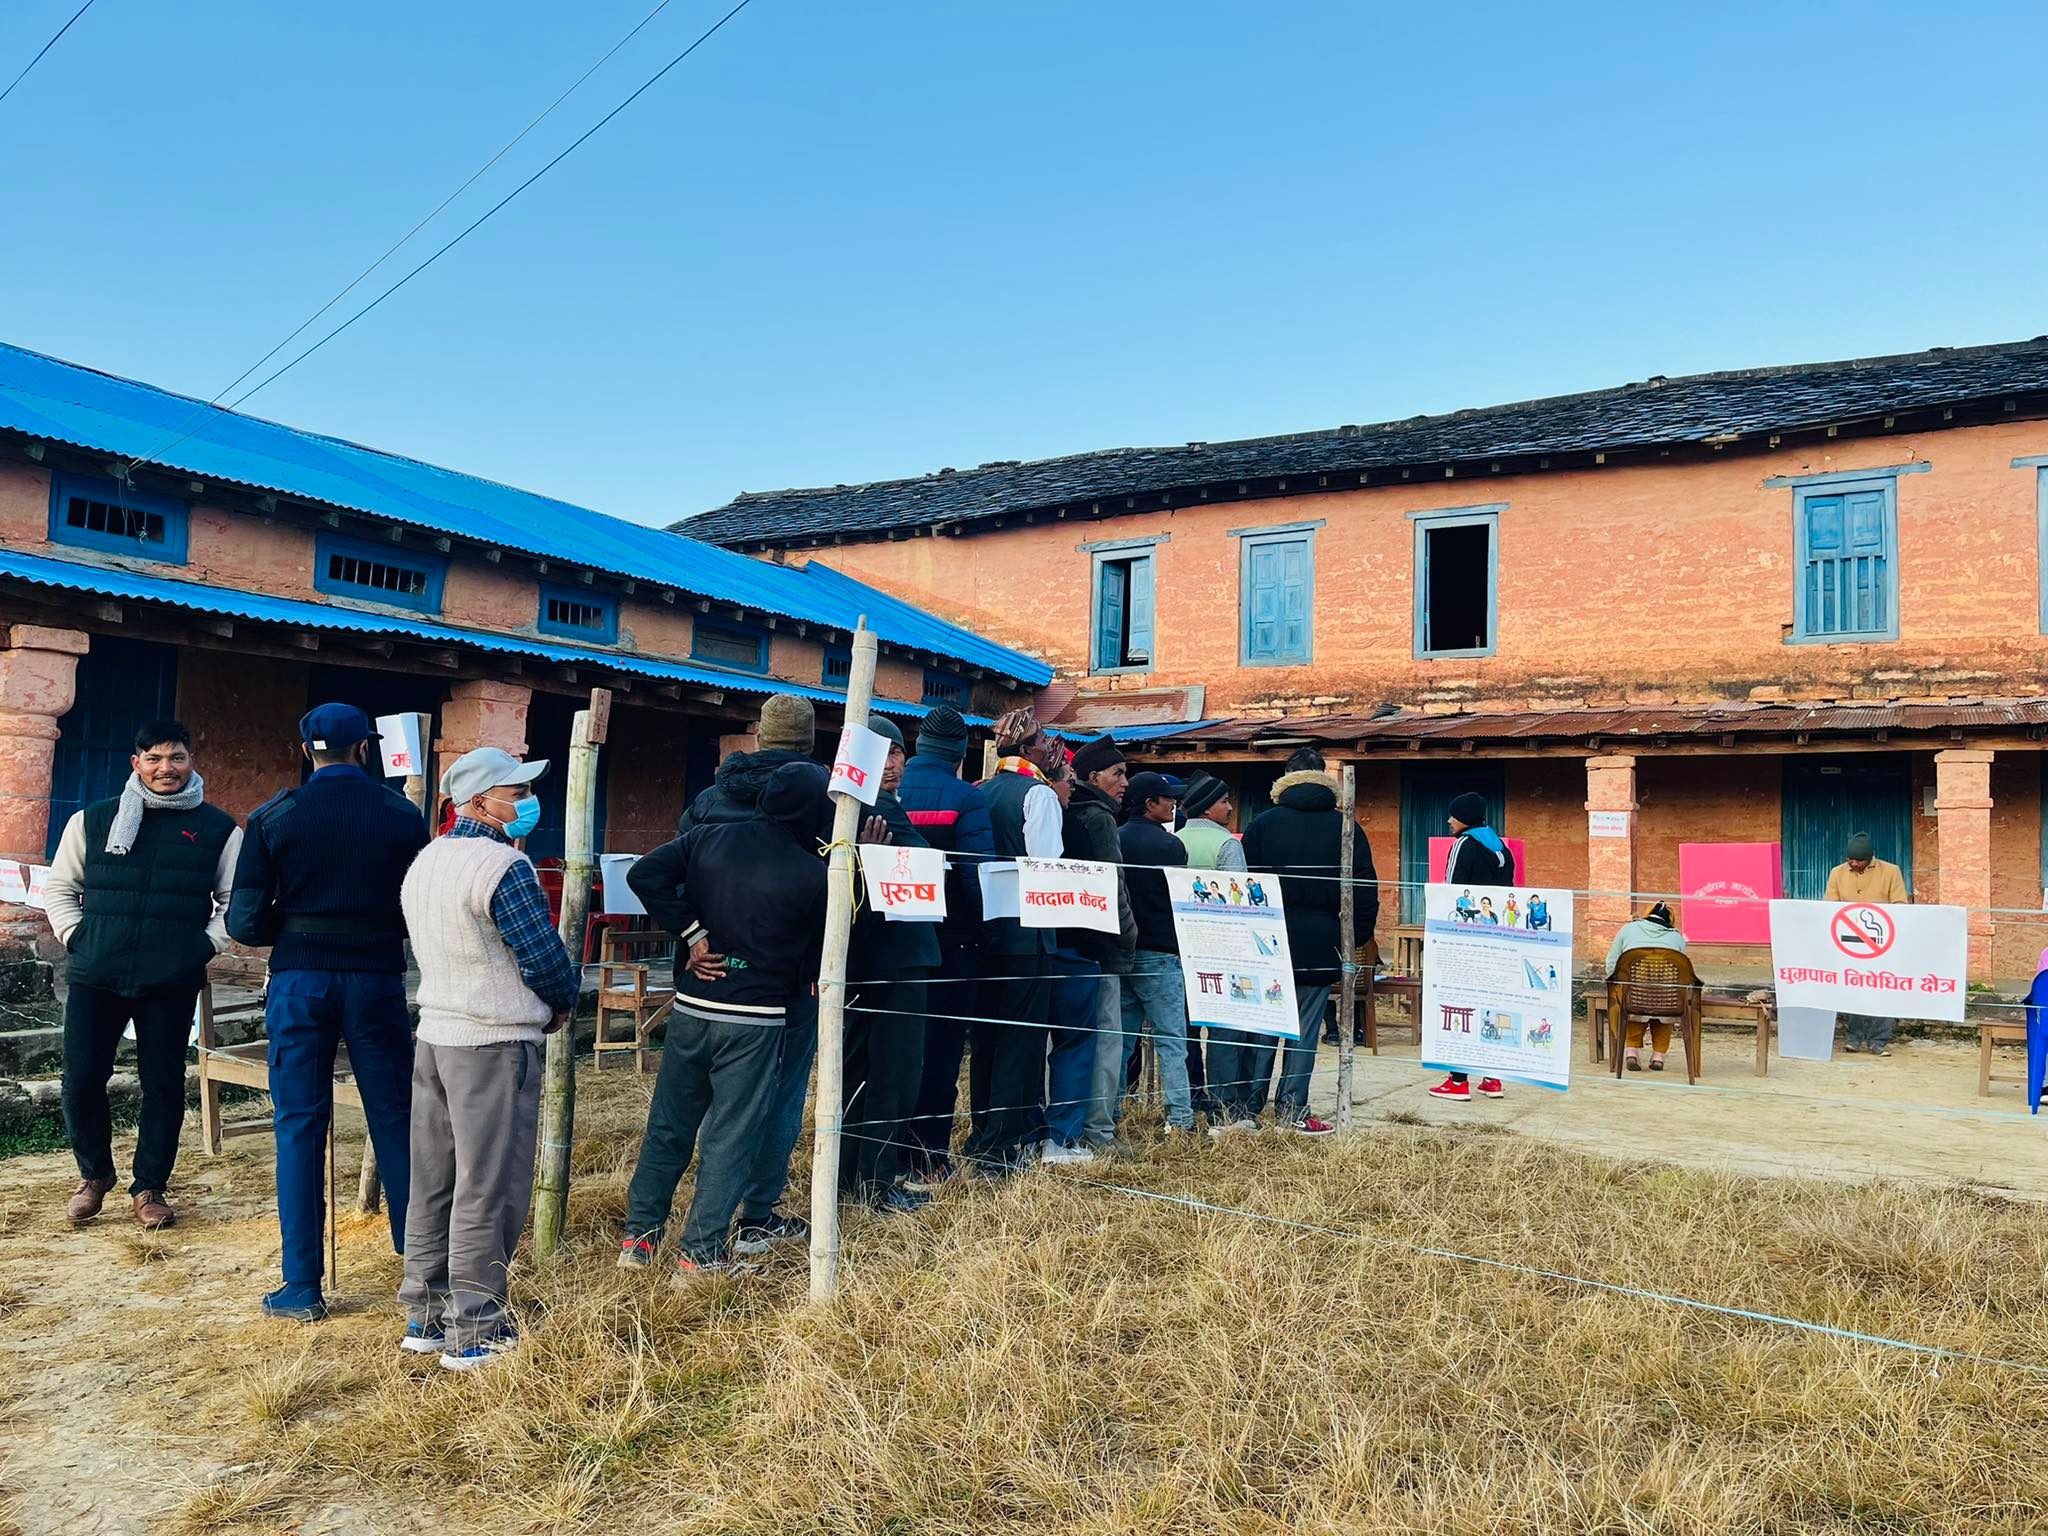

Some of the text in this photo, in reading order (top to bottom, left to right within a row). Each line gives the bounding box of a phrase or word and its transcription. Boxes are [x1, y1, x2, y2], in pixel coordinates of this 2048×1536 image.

[1025, 889, 1108, 912] मतदान केन्द्र
[1843, 968, 1914, 991] निषेधित
[1920, 973, 1957, 993] क्षेत्र
